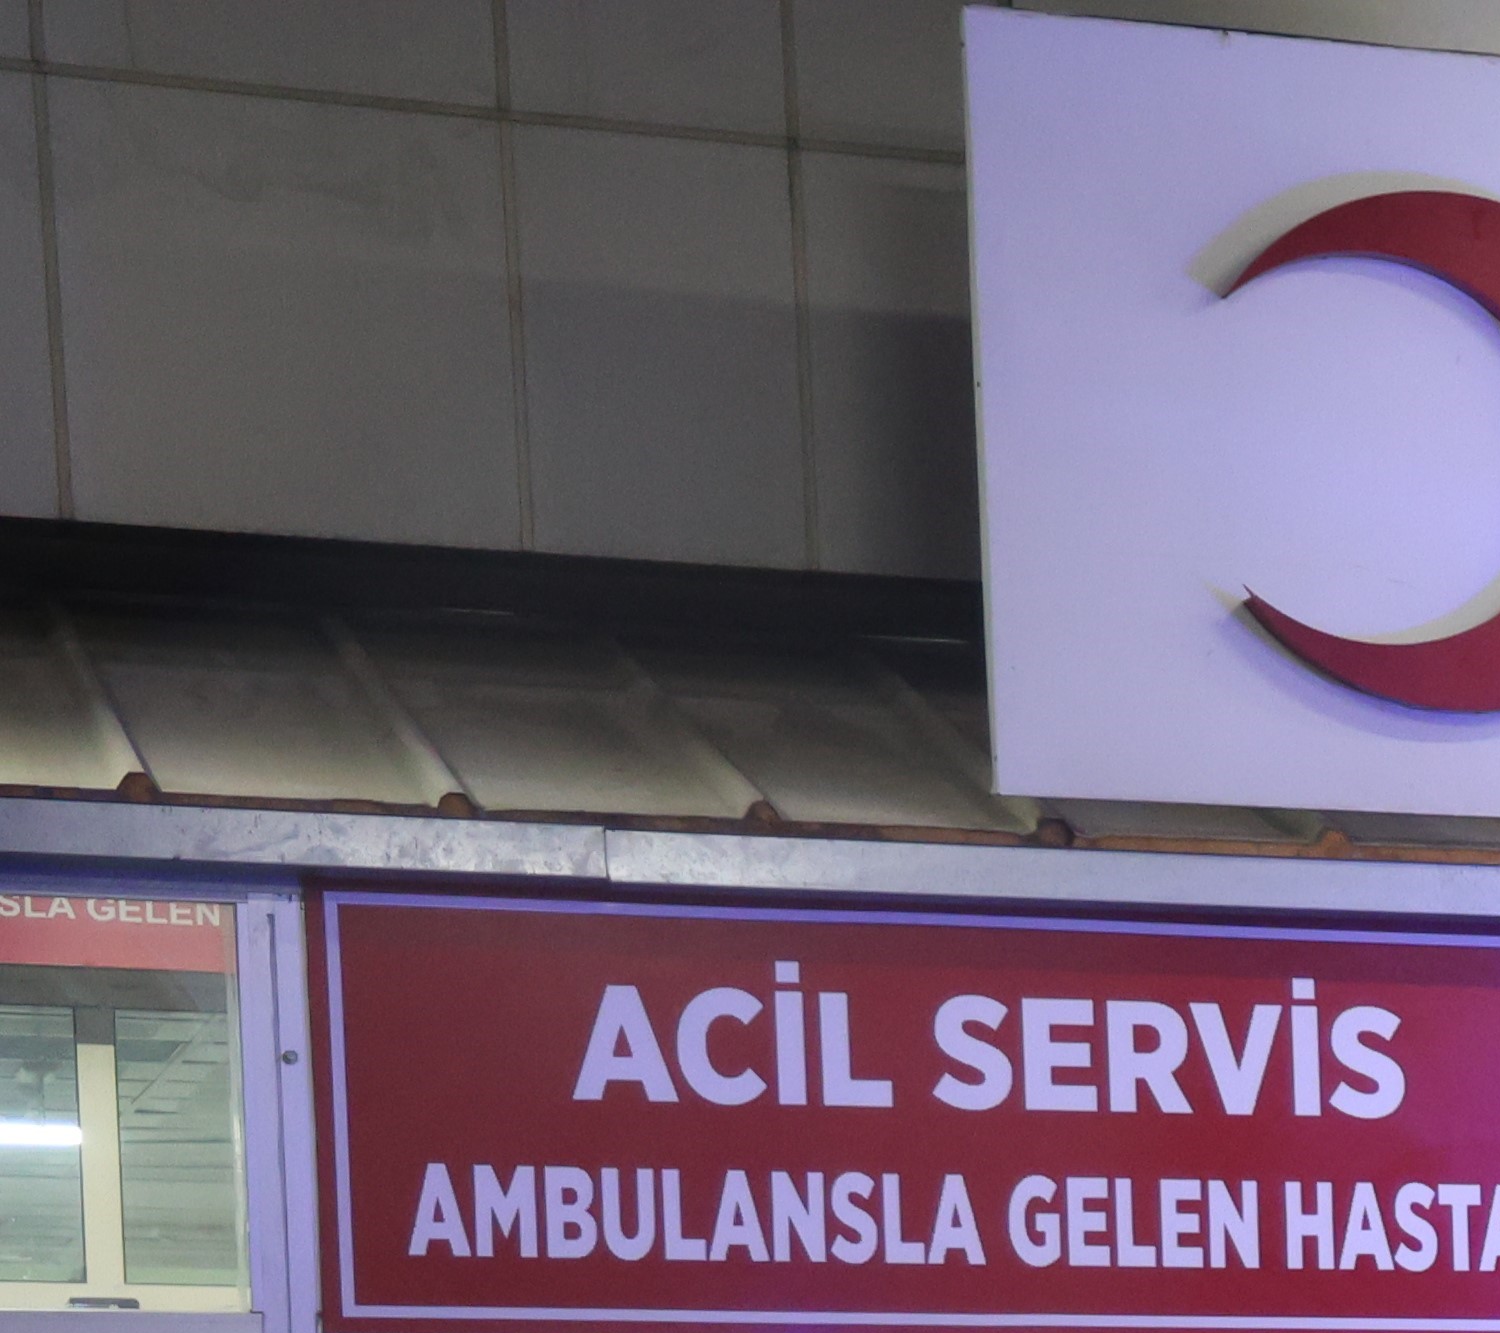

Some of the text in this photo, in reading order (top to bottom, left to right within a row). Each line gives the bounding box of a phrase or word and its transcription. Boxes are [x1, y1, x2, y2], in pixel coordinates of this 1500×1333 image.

[573, 960, 1406, 1120] ACİL SERVİS
[408, 1162, 987, 1266] AMBULANSLA
[1008, 1174, 1260, 1269] GELEN
